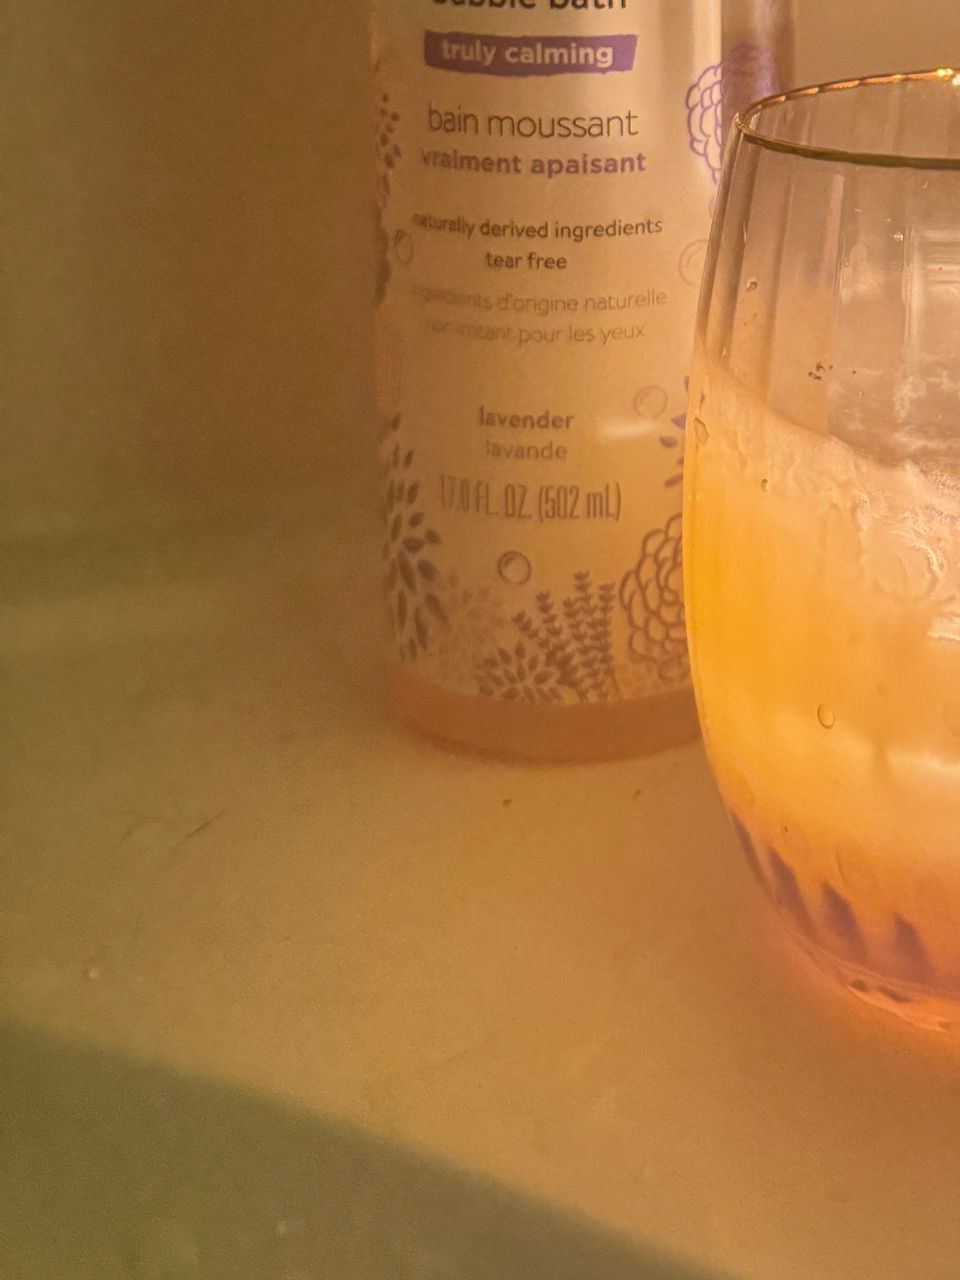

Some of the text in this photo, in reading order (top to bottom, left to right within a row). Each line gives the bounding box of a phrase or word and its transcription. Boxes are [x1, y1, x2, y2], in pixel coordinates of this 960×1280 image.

[441, 40, 613, 67] truly calming
[427, 100, 640, 138] bain moussant
[422, 147, 648, 178] vraiment apaisant
[480, 218, 549, 239] derived
[554, 218, 664, 243] ingredients
[484, 251, 568, 269] tear free
[584, 288, 668, 311] naturelle
[518, 326, 564, 347] pour
[568, 324, 596, 343] les
[601, 322, 647, 346] yeux
[479, 405, 576, 429] lavender
[485, 438, 568, 461] lavande
[538, 484, 580, 523] (502
